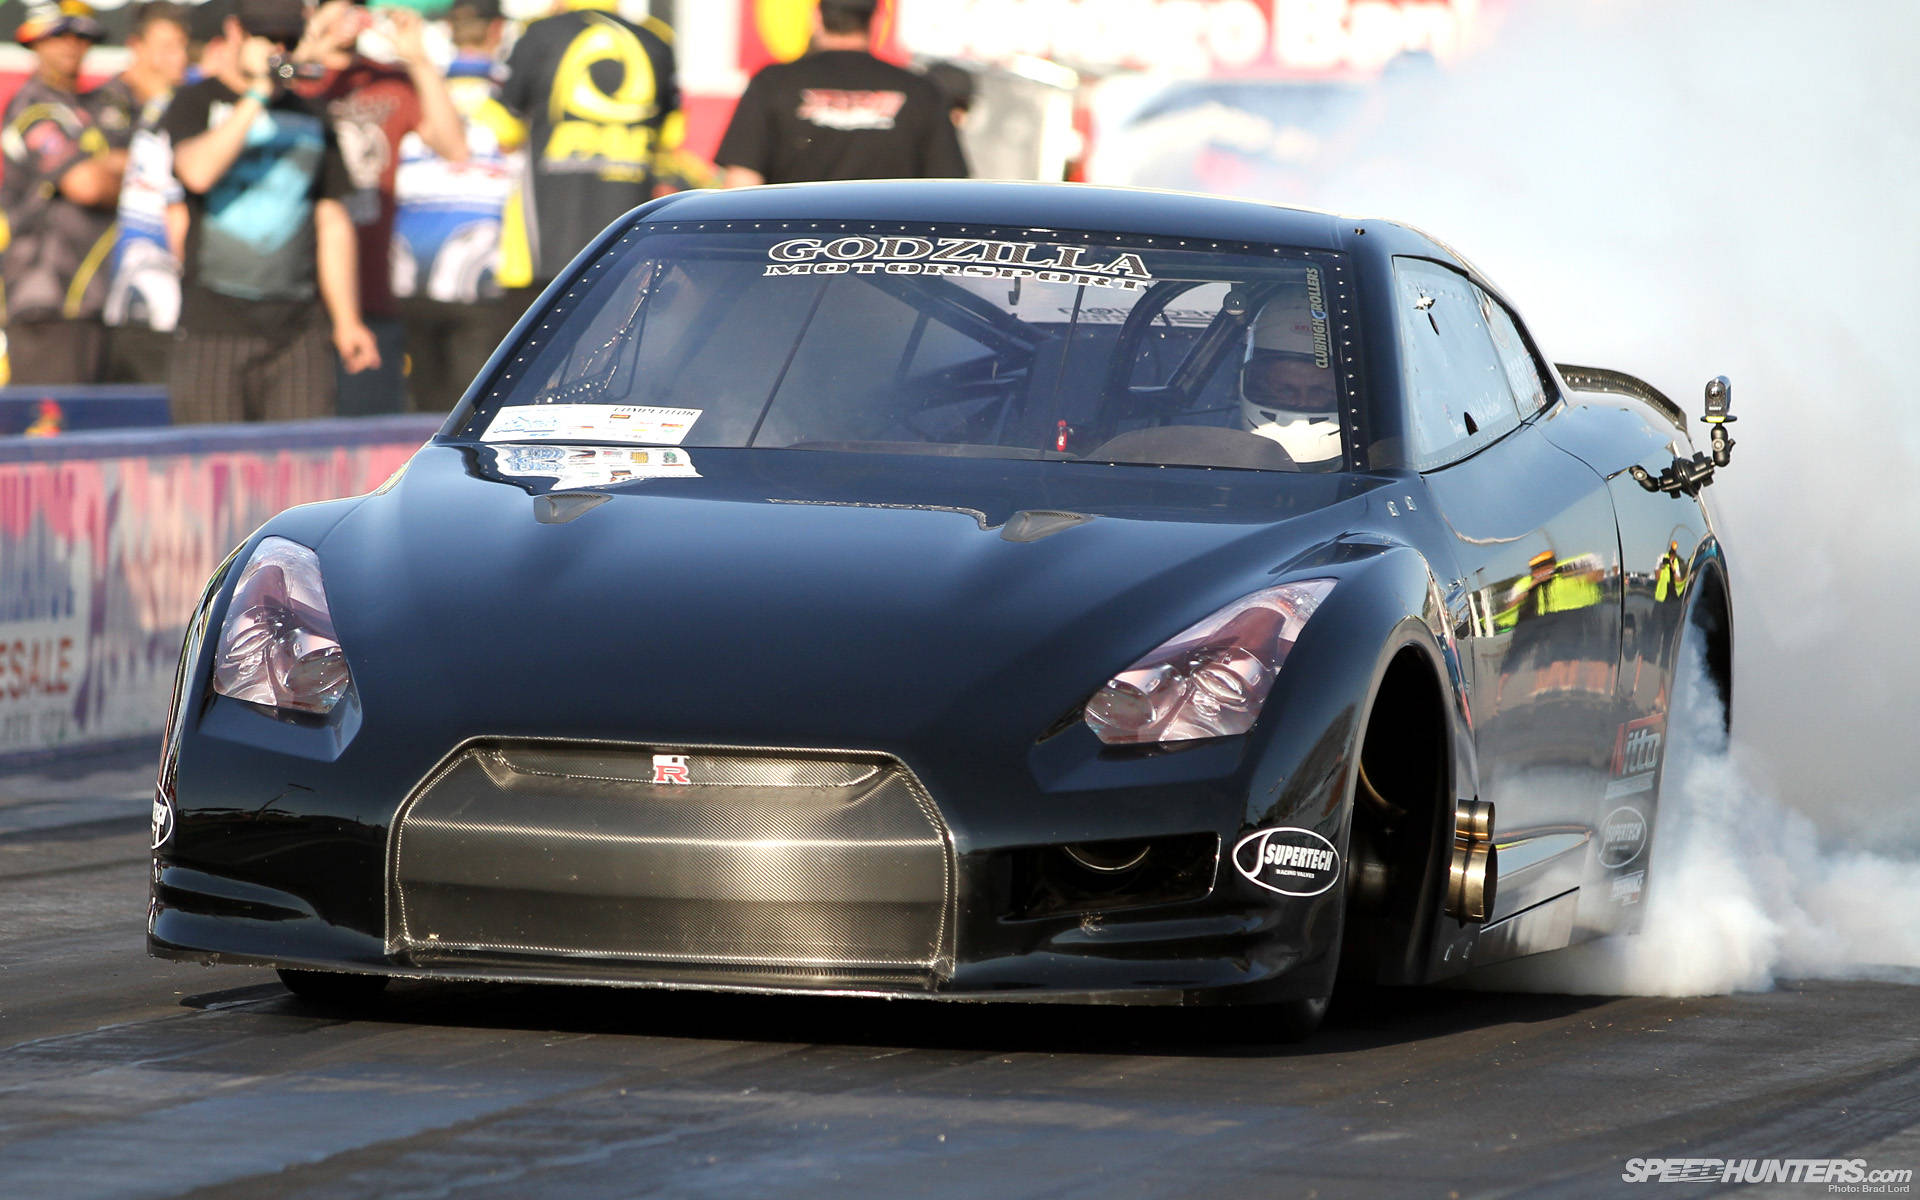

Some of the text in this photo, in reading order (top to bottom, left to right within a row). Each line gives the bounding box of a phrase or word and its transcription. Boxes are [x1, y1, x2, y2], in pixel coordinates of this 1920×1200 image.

[767, 237, 1153, 279] GODZILLA
[761, 262, 1150, 291] MOTORSPORT
[1264, 843, 1335, 872] SUPERTECH
